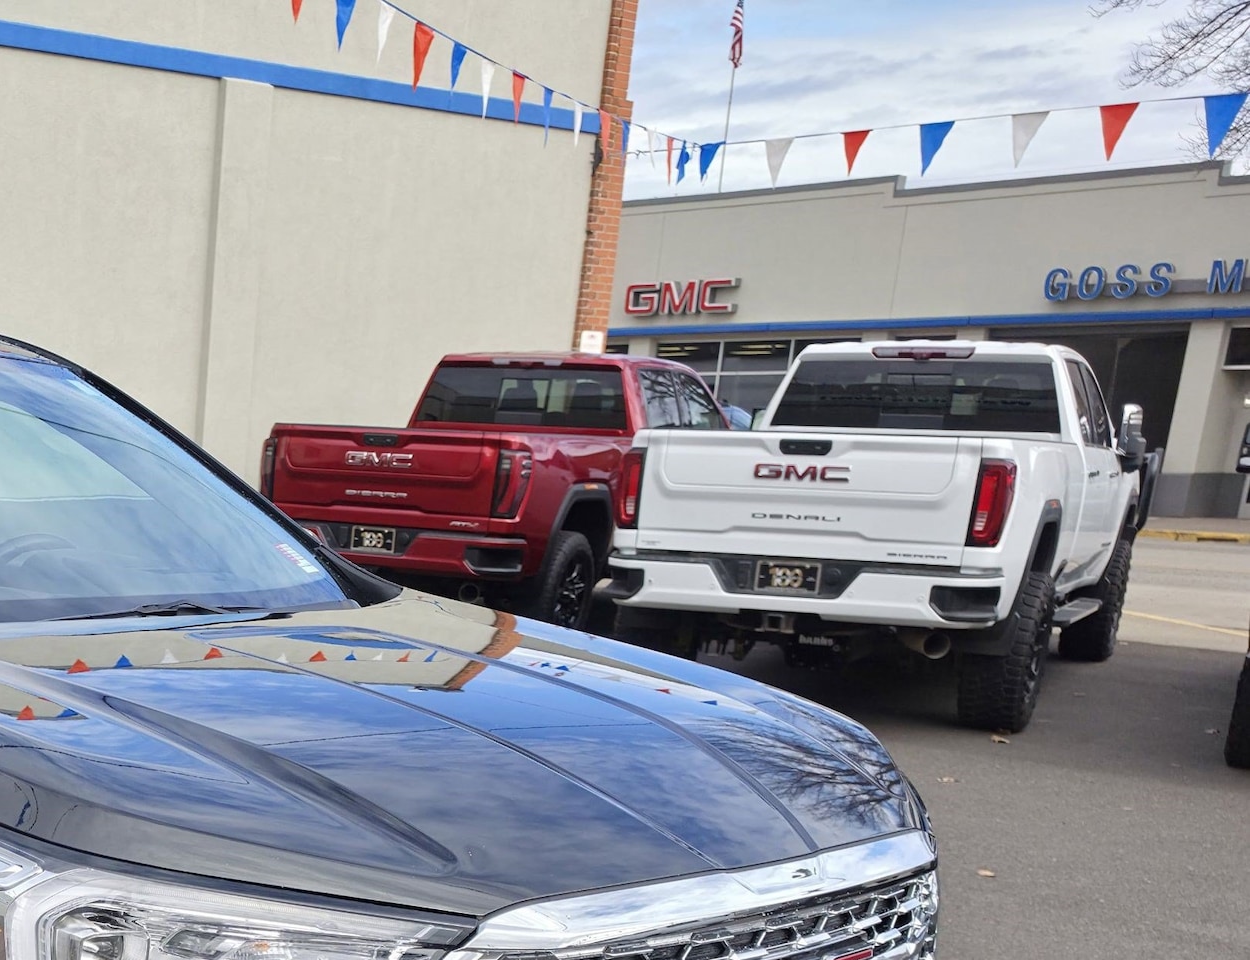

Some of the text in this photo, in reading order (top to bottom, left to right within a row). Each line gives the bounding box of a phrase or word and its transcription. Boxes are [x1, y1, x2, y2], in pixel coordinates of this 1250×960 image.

[1043, 261, 1175, 302] GOSS
[624, 278, 738, 316] GMC
[344, 450, 414, 469] GMC
[753, 462, 851, 484] GMC
[751, 512, 841, 523] DENALI
